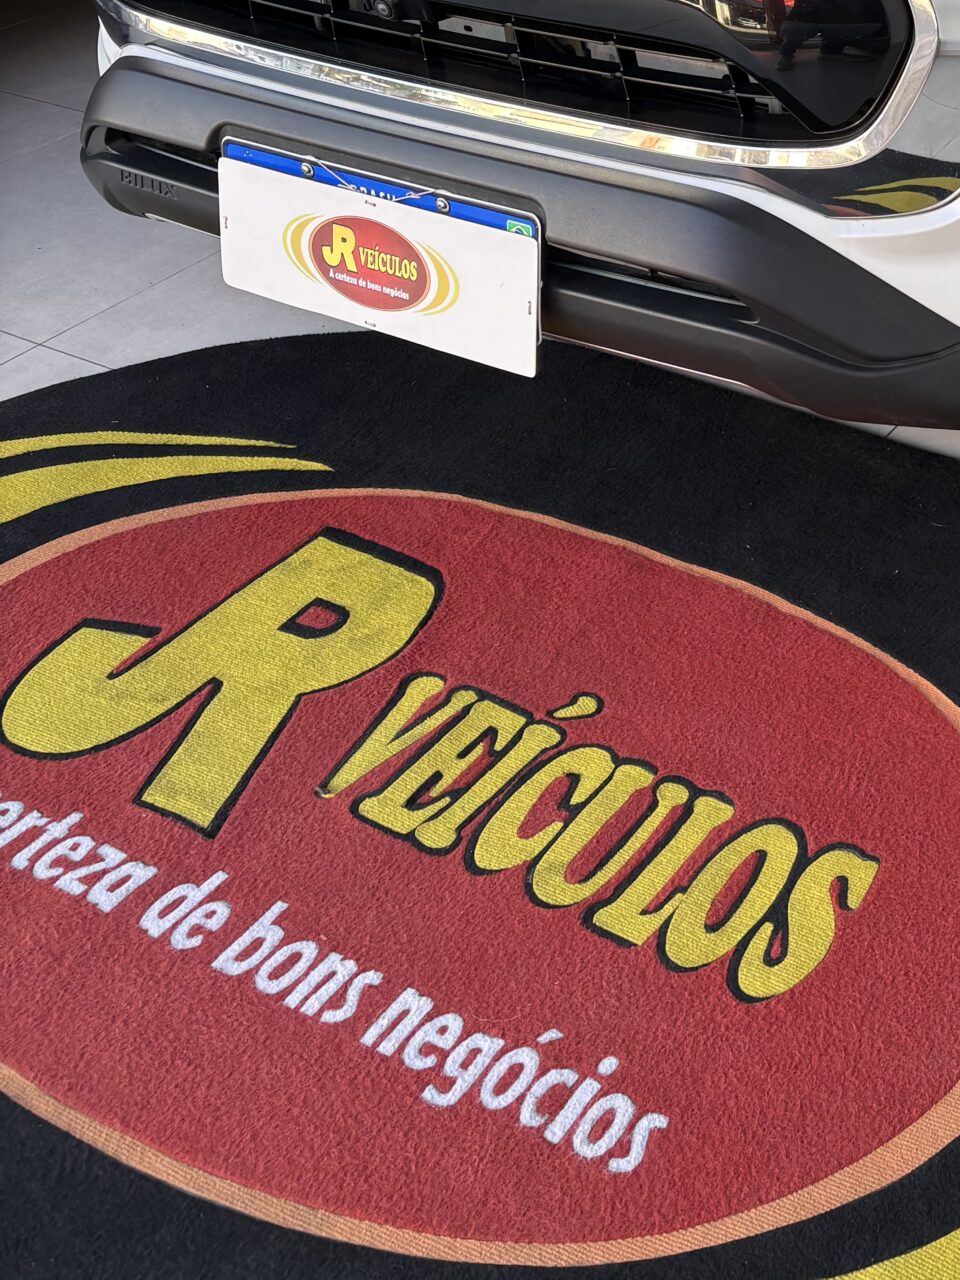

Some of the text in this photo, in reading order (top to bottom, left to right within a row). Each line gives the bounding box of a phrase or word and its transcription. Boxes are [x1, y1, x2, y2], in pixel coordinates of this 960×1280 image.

[329, 268, 335, 279] A
[335, 272, 357, 286] certeza
[358, 278, 367, 289] de
[367, 280, 382, 292] bons
[358, 244, 418, 282] VEÍCULOS
[316, 672, 880, 1003] VEÍCULOS
[139, 871, 232, 951] de
[213, 901, 383, 1025] bons
[362, 986, 668, 1173] negócios
